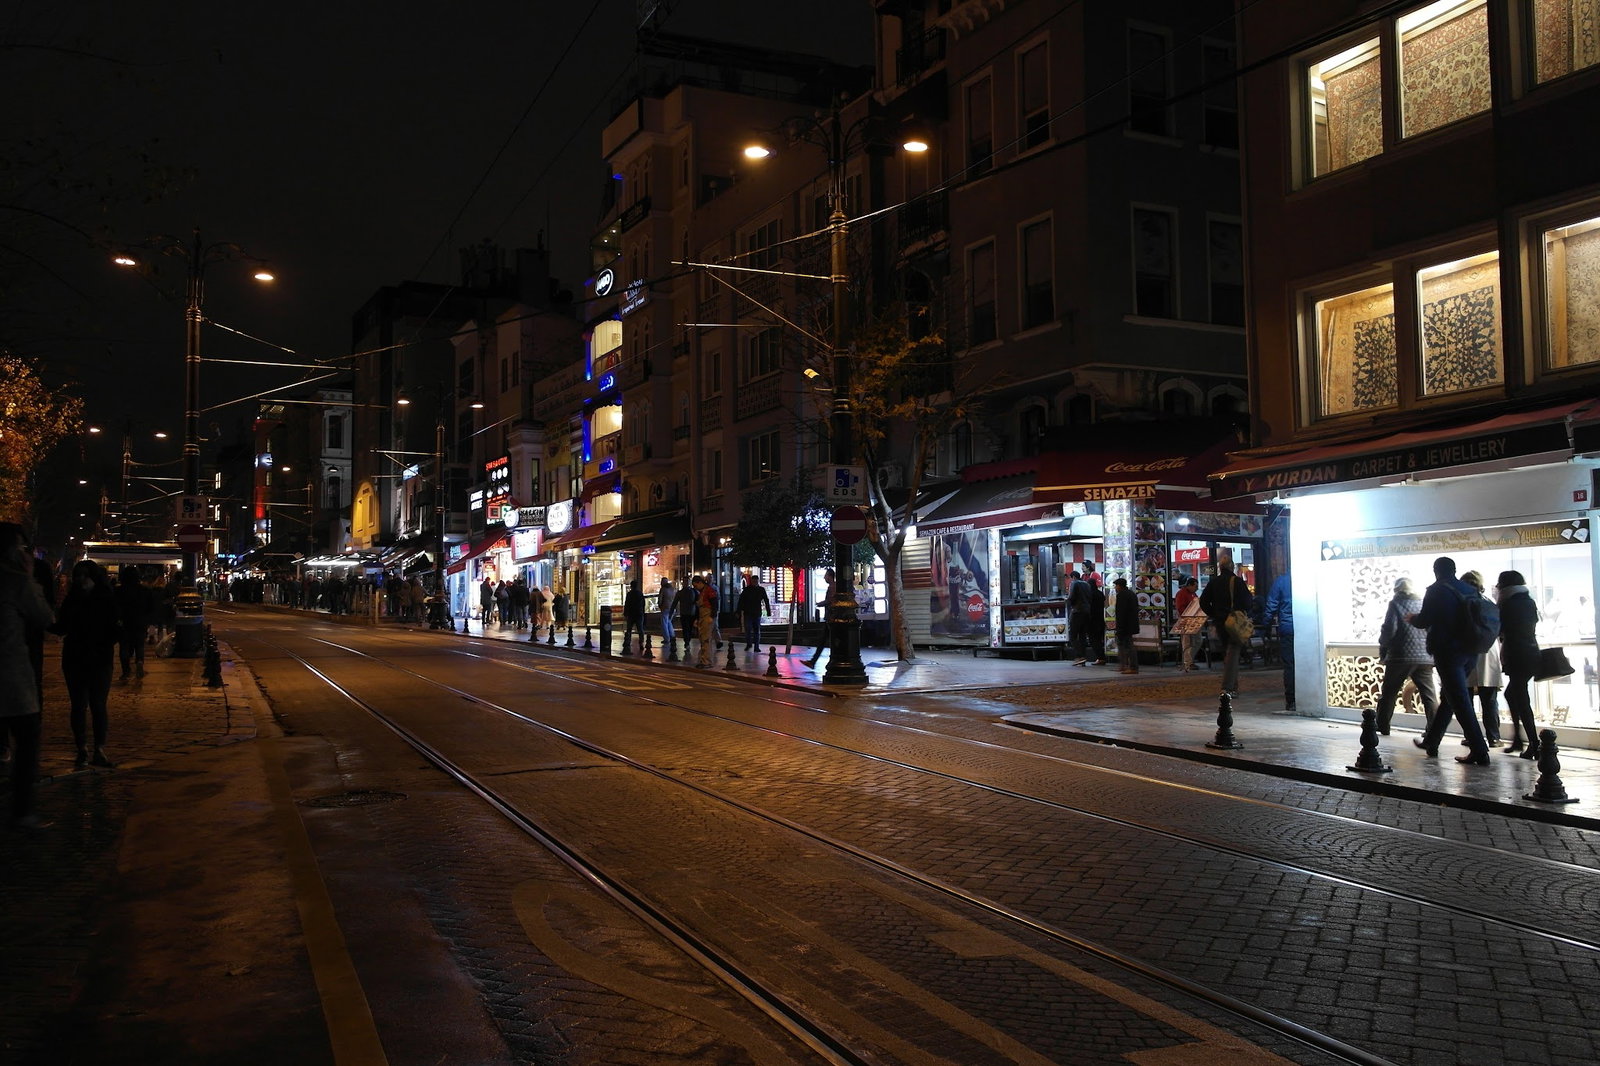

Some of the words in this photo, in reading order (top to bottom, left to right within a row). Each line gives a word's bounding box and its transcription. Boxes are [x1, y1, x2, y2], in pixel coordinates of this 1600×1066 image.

[1105, 456, 1187, 472] Coca-Cola
[1266, 464, 1338, 488] YURDAN
[1352, 455, 1402, 476] CARPET
[1407, 455, 1416, 468] &
[1422, 438, 1507, 466] JEWELLERY
[833, 488, 857, 496] EDS
[1083, 485, 1155, 501] SEMAZEN
[936, 527, 947, 535] CAFE
[949, 523, 975, 532] RESTAURANT
[1181, 550, 1202, 561] Coca-Cola
[967, 602, 984, 612] Coca-Cola
